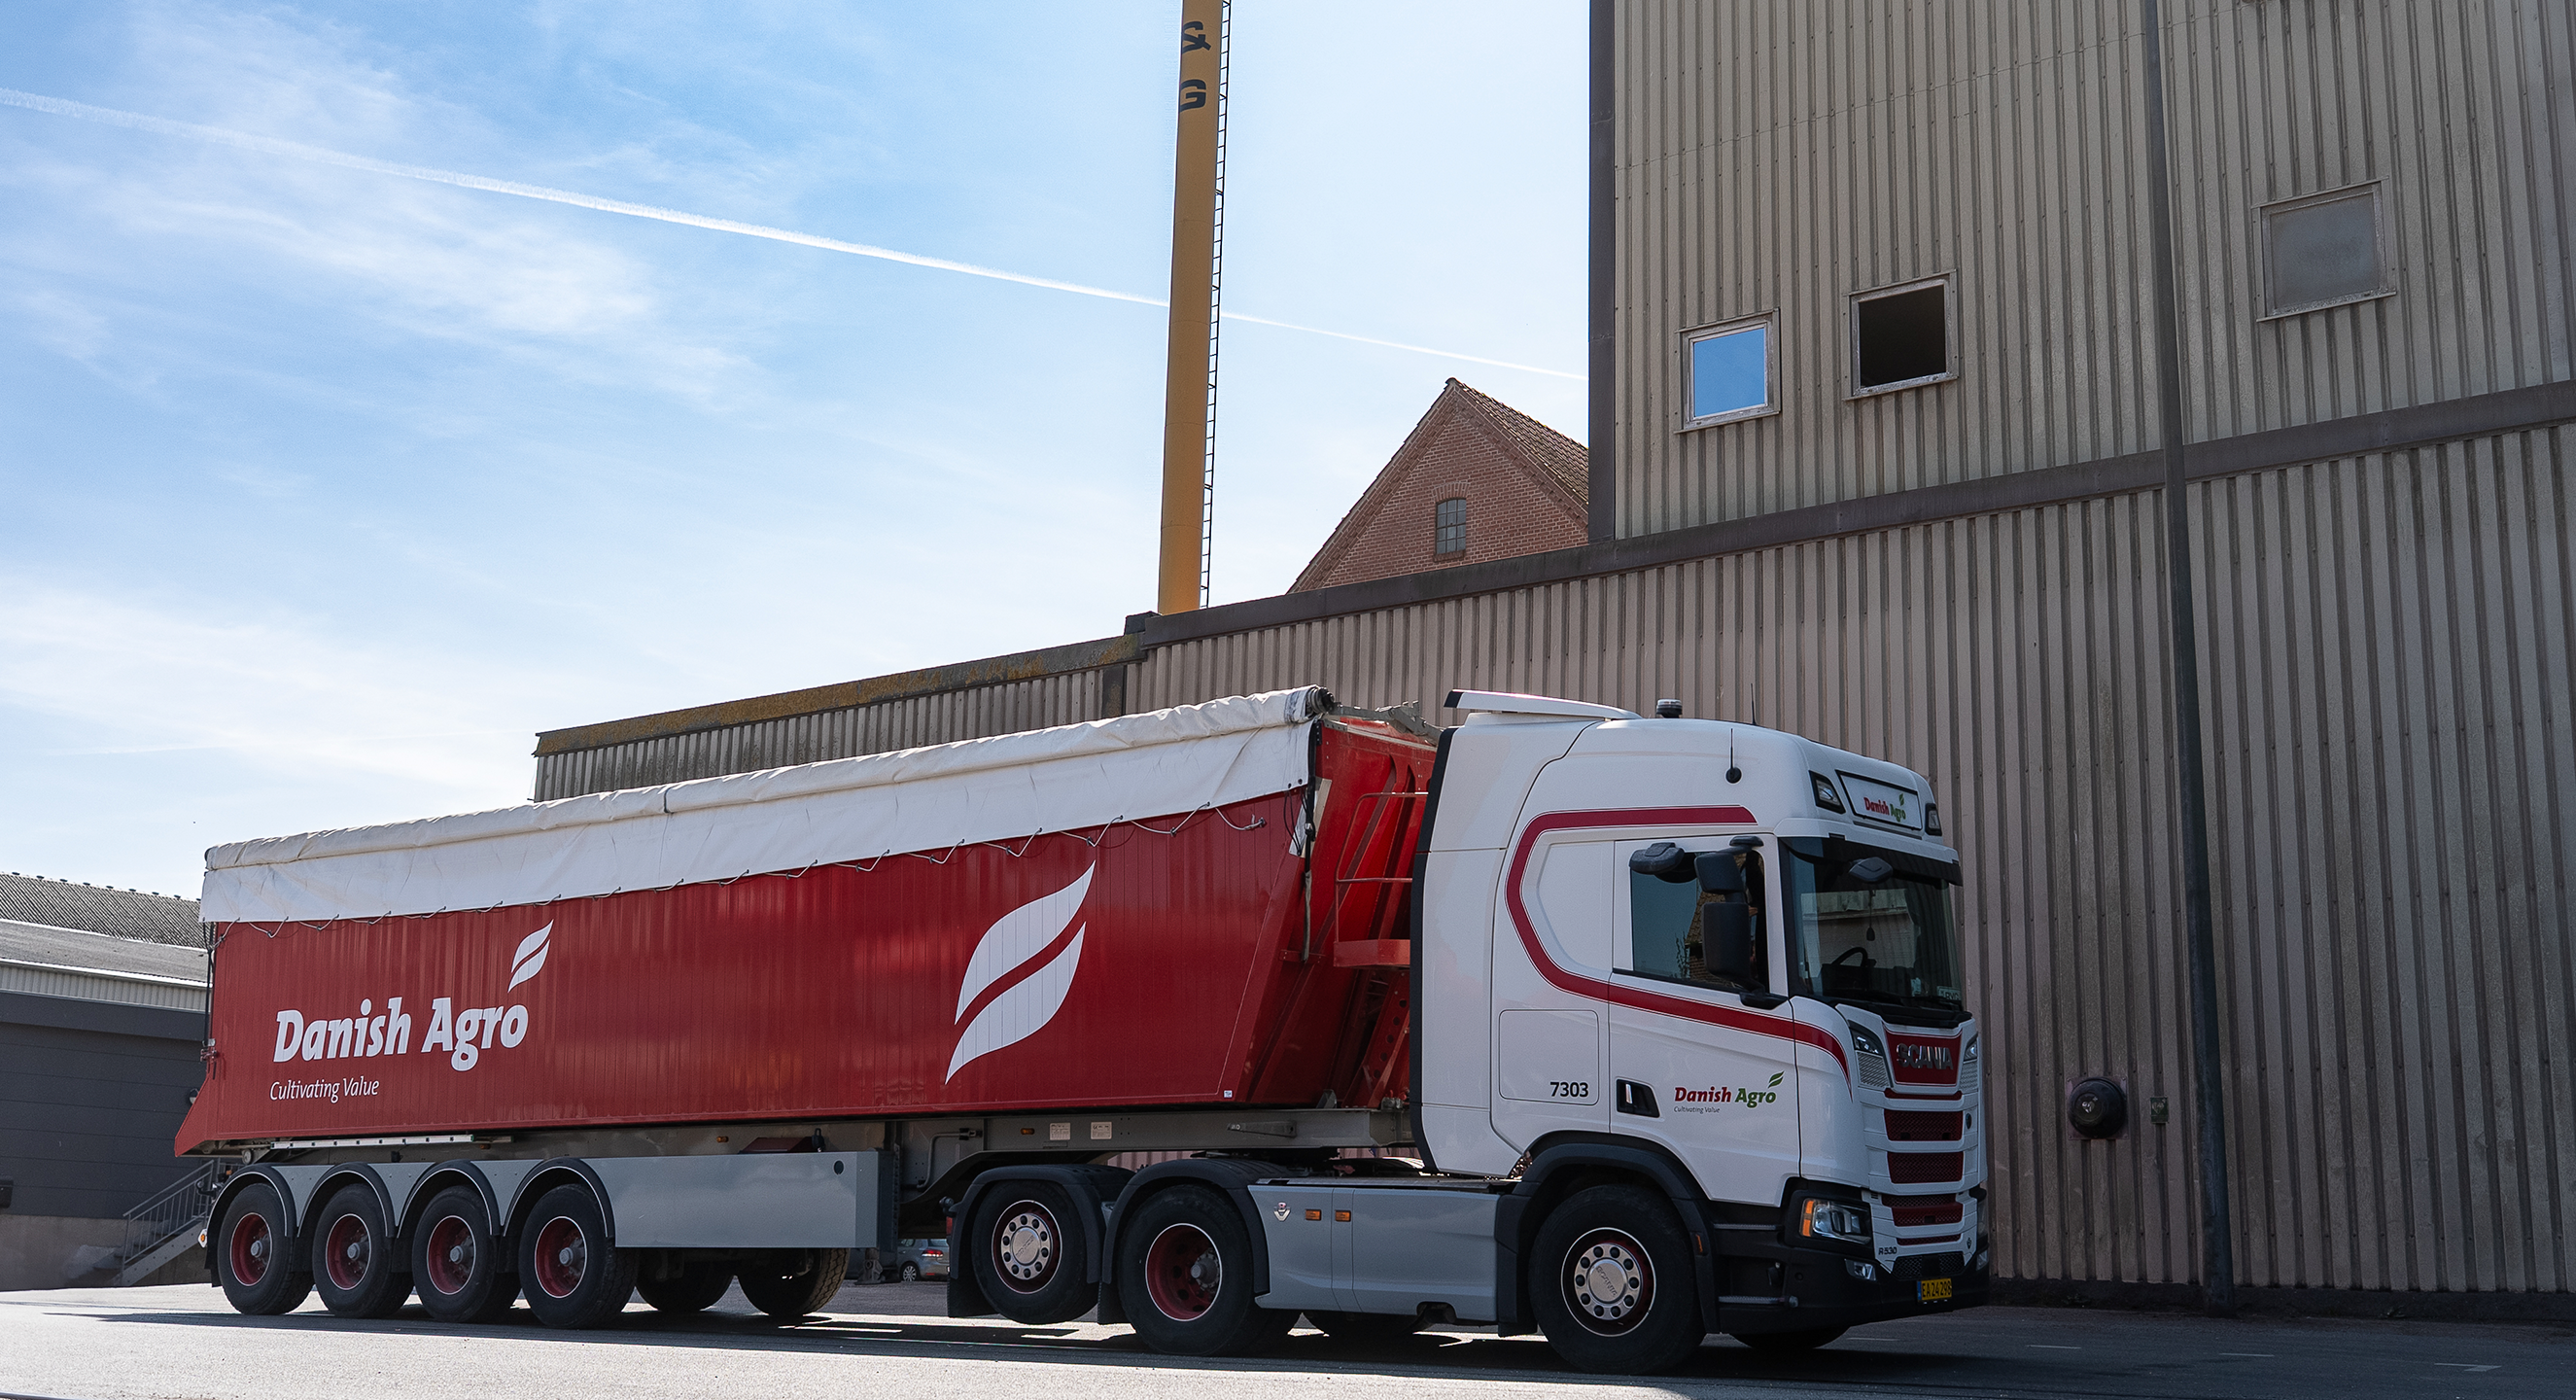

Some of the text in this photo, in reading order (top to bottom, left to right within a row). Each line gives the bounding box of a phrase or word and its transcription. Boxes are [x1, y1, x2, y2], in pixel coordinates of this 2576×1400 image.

[1179, 79, 1207, 113] G
[1863, 796, 1906, 822] Danish Agro
[273, 997, 530, 1071] Danish Agro
[1896, 1042, 1954, 1070] SCANIA
[269, 1075, 380, 1103] Cultivating Value
[1549, 1081, 1589, 1098] 7303
[1674, 1086, 1777, 1108] Danish Agro
[1673, 1105, 1704, 1114] Cultivating
